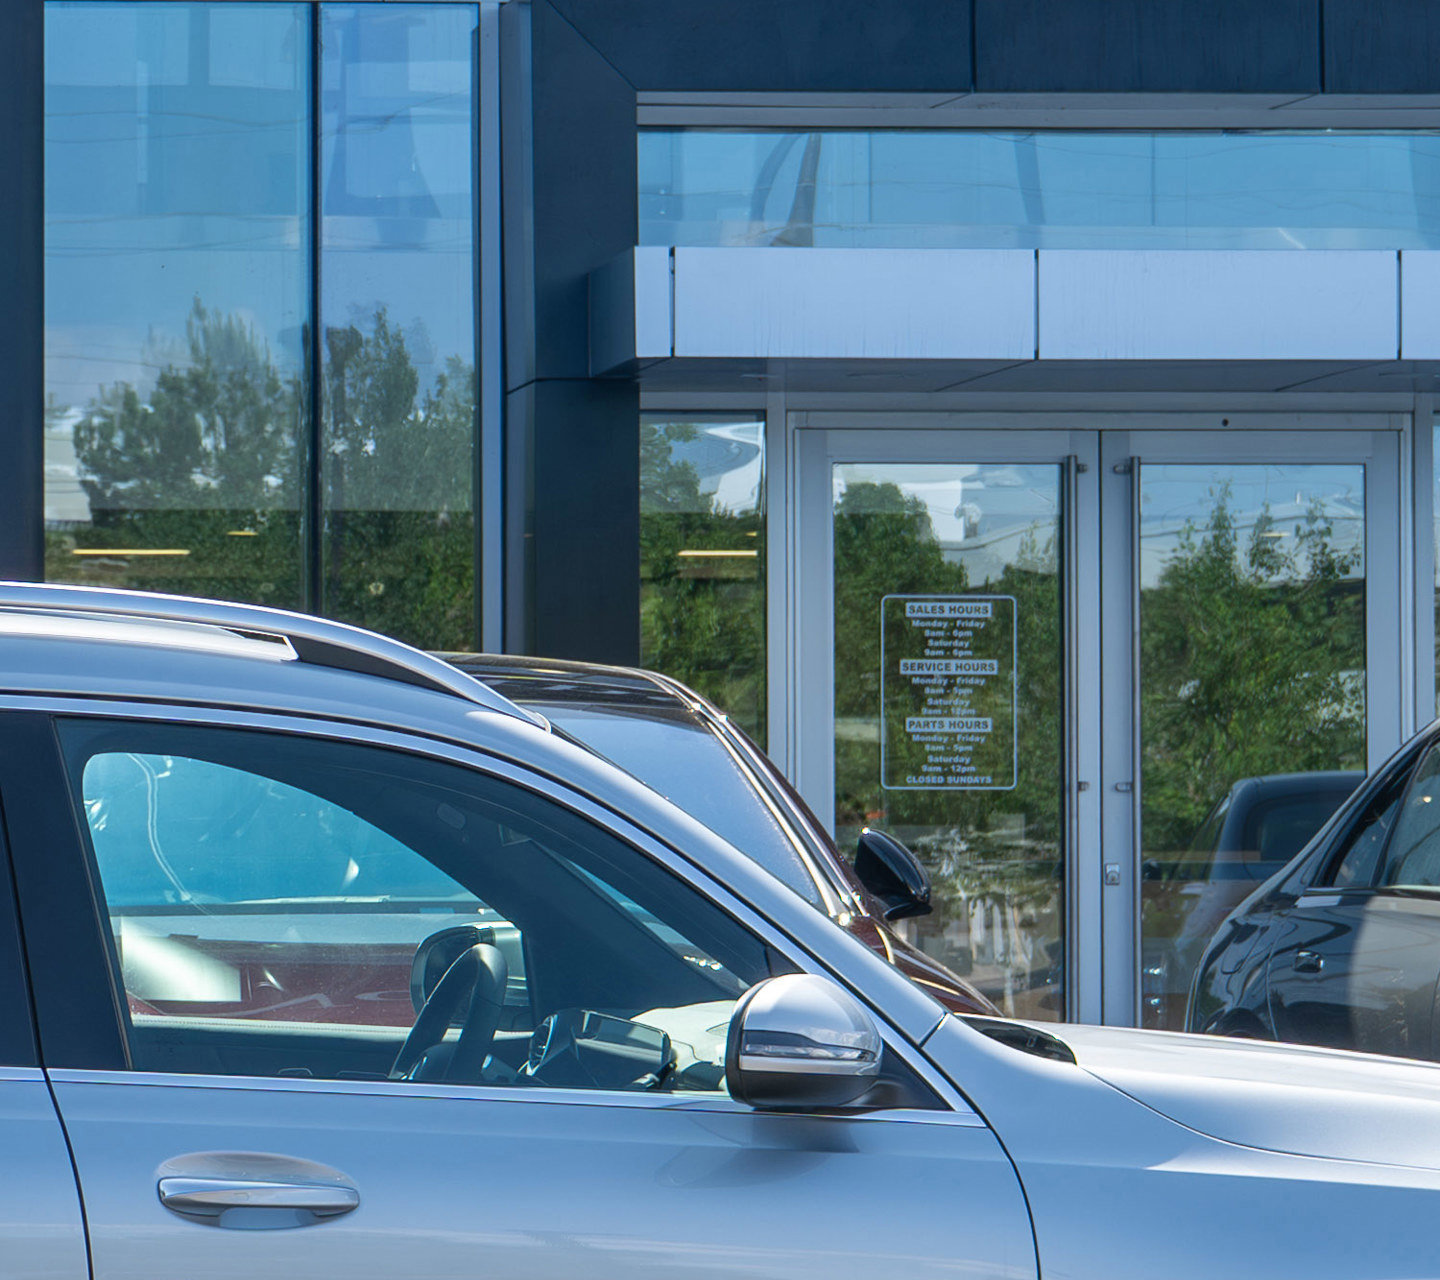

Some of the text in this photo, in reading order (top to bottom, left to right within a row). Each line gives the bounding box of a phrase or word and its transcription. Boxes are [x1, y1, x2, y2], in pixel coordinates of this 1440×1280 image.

[908, 605, 989, 614] SALES HOURS
[912, 619, 949, 628] Monday
[956, 619, 986, 629] Friday
[928, 638, 970, 648] Saturday
[902, 662, 995, 672] SERVICE HOURS
[912, 677, 949, 686] Monday
[956, 677, 986, 686] Friday
[927, 697, 970, 707] Saturday
[908, 720, 989, 729] PARTS HOURS
[912, 734, 949, 743] Monday
[957, 734, 986, 744] Friday
[927, 755, 971, 765] Saturday
[951, 764, 976, 774] 12pm
[906, 775, 992, 784] CLOSED SUNDAYS
